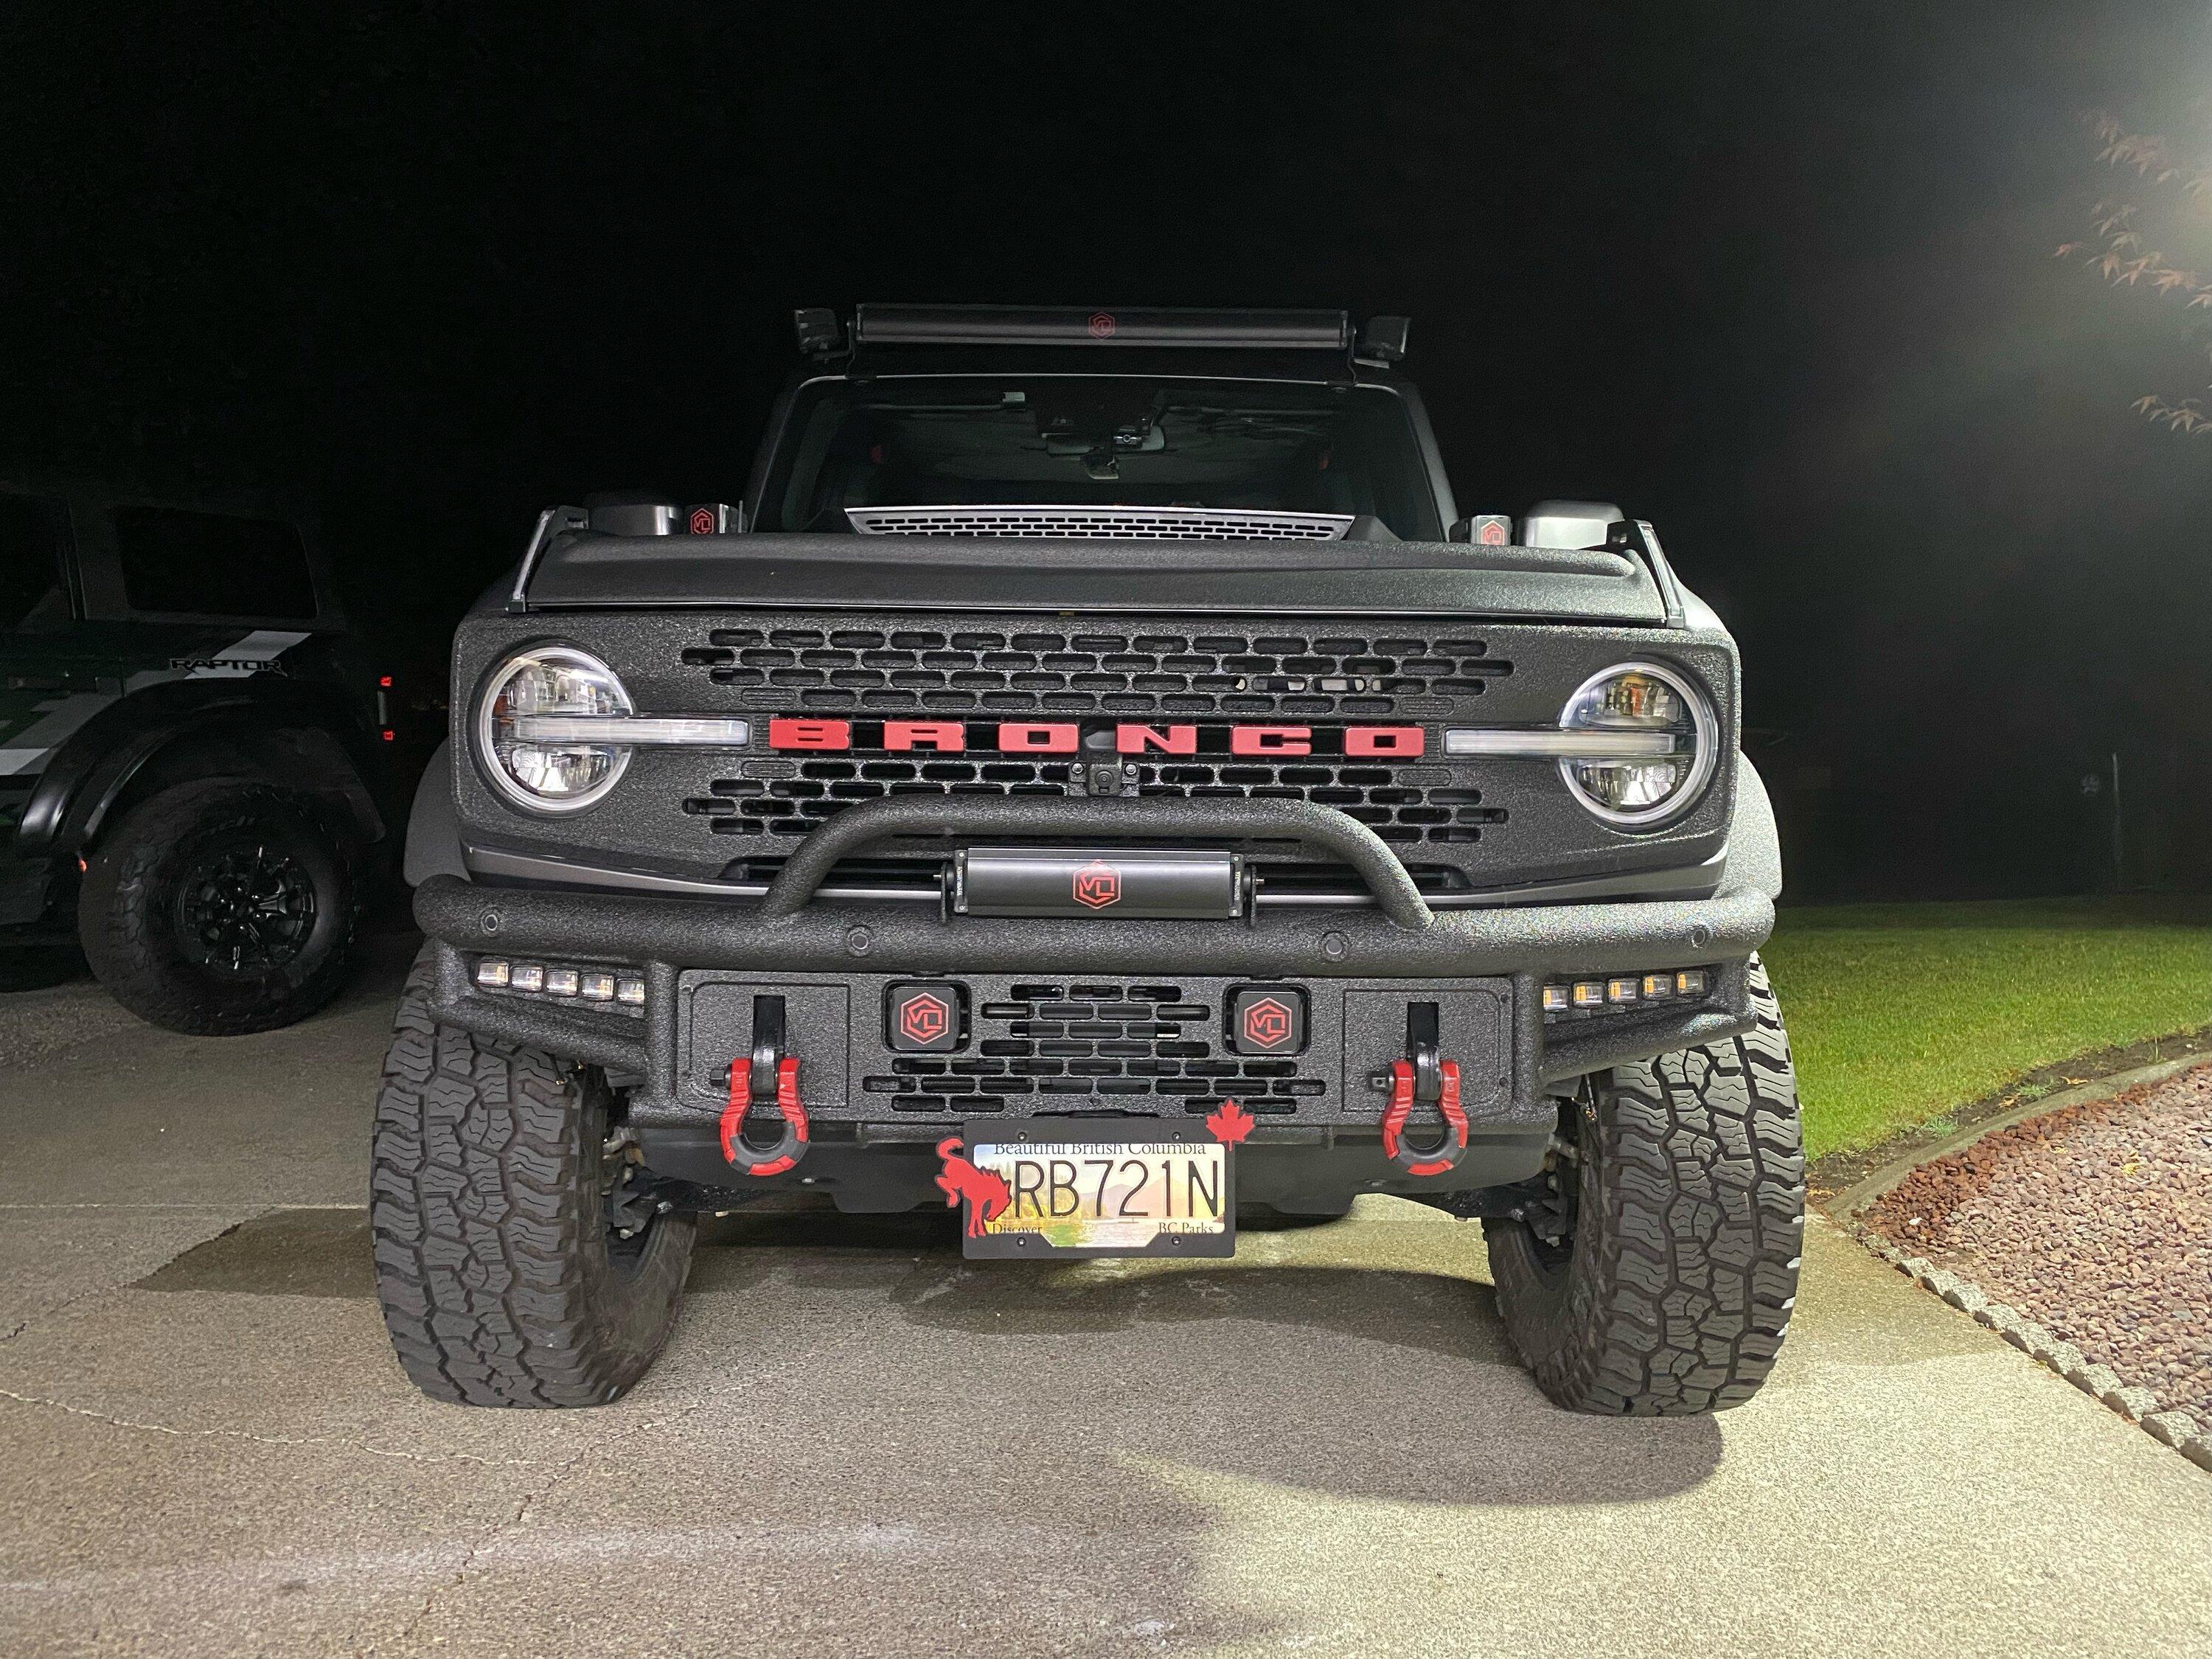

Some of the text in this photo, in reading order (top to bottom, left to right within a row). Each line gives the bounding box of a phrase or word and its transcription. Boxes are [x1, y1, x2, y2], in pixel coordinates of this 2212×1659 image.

[170, 658, 288, 678] RAPTOR
[769, 720, 1425, 757] BRONCO
[994, 1144, 1207, 1155] Beautiful British Columbia
[1015, 1160, 1218, 1218] RB721N
[992, 1223, 1043, 1234] Discover
[1158, 1222, 1214, 1234] BC Parks
